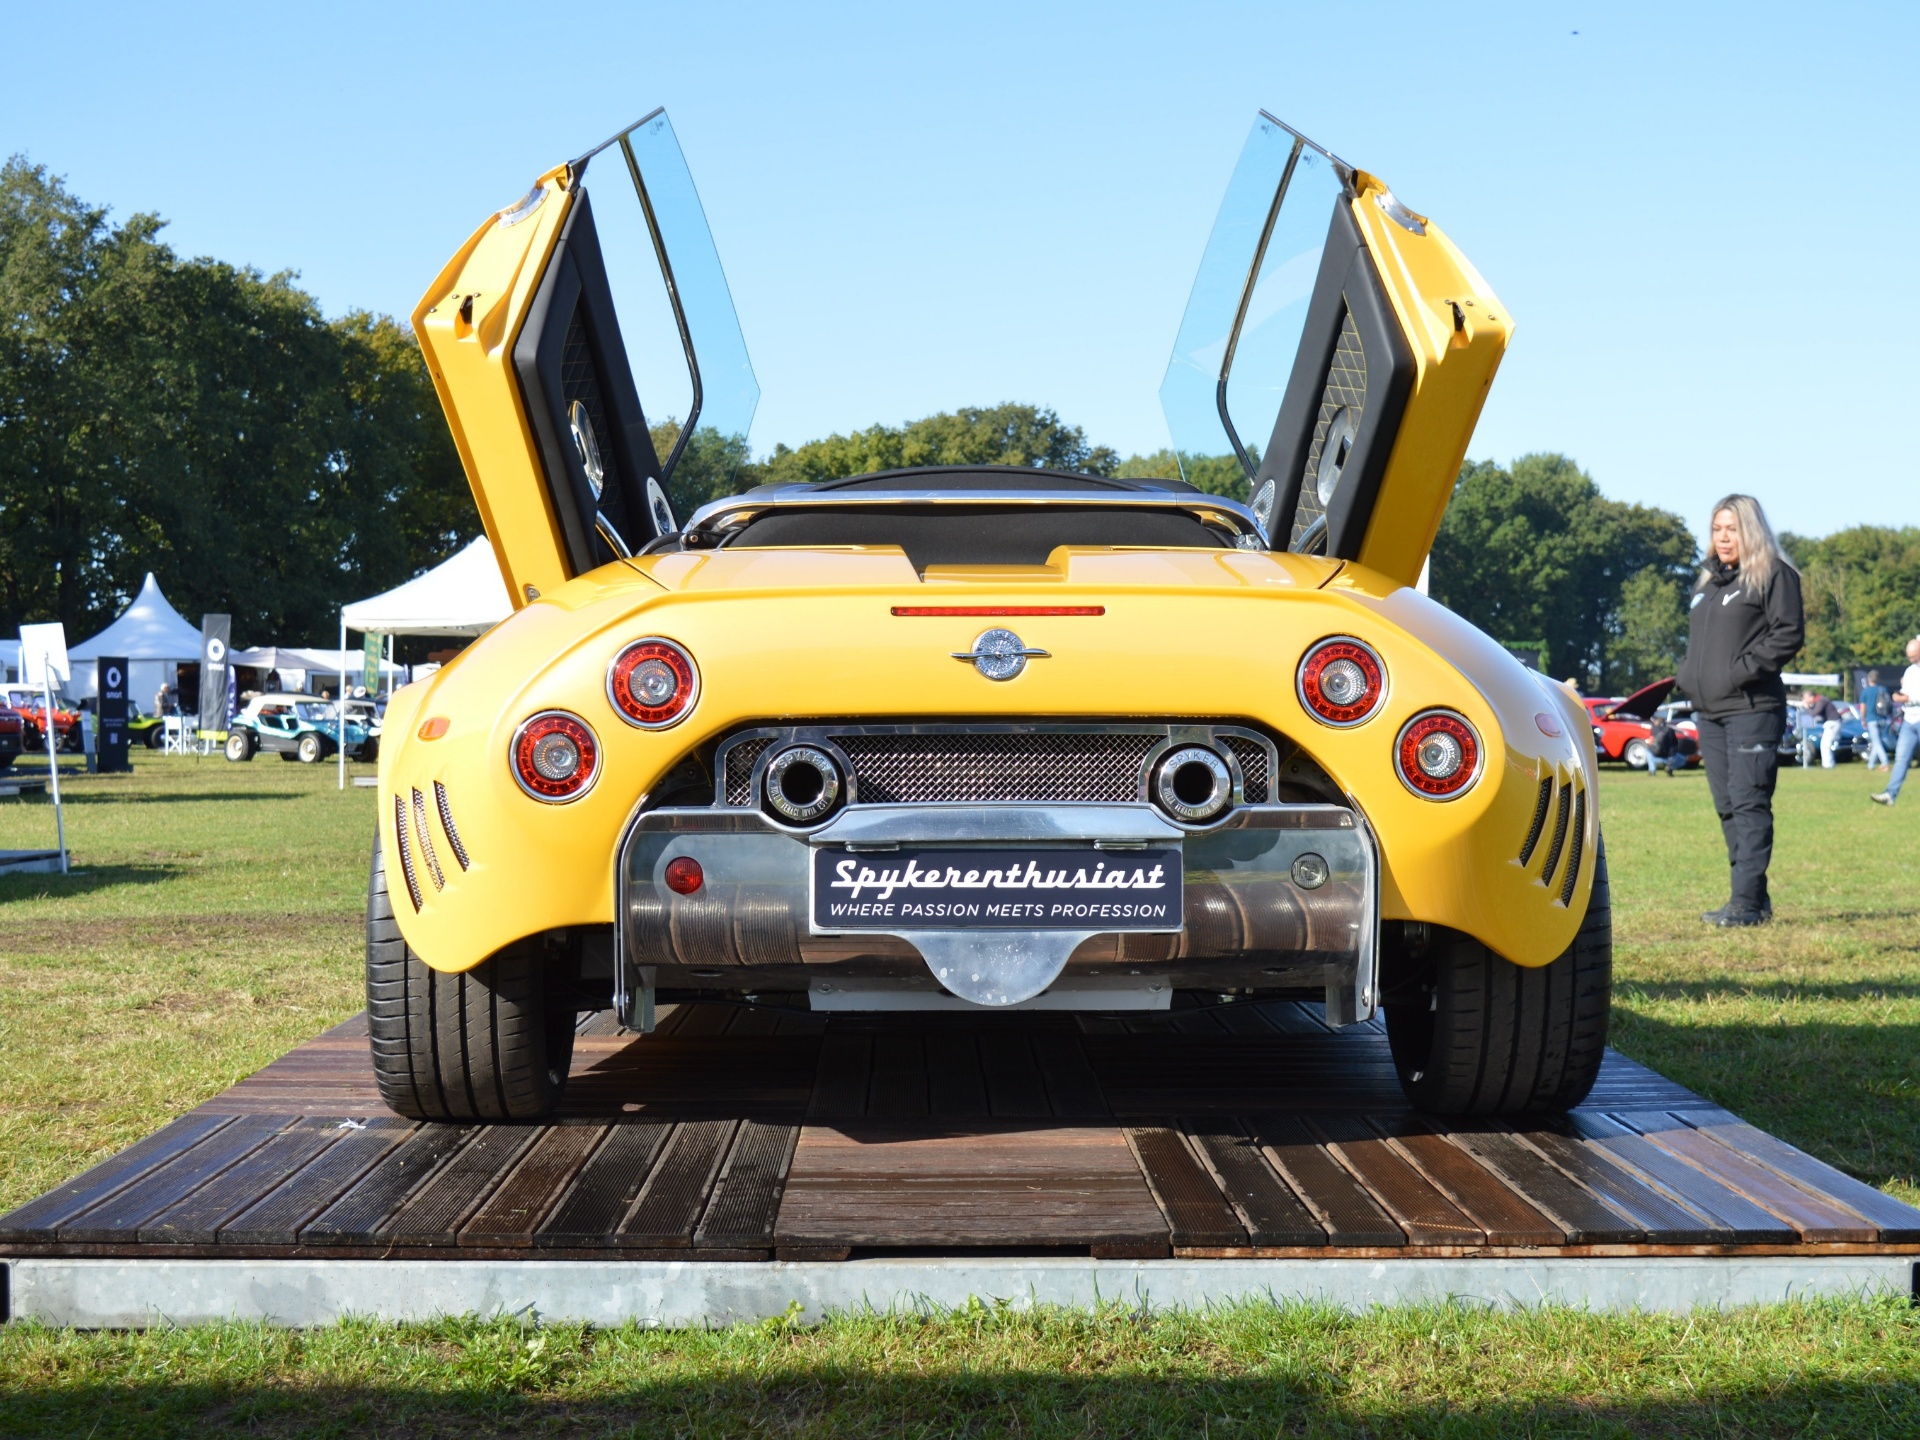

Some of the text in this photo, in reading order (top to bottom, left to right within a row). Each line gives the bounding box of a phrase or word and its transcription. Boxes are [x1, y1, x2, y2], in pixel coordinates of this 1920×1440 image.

[777, 749, 829, 770] SPYKER
[1169, 751, 1219, 769] SPYKER
[817, 799, 828, 811] EST
[831, 860, 1166, 899] Spykerenthusiast
[831, 903, 1166, 917] WHERE PASSION MEETS PROFESSION
